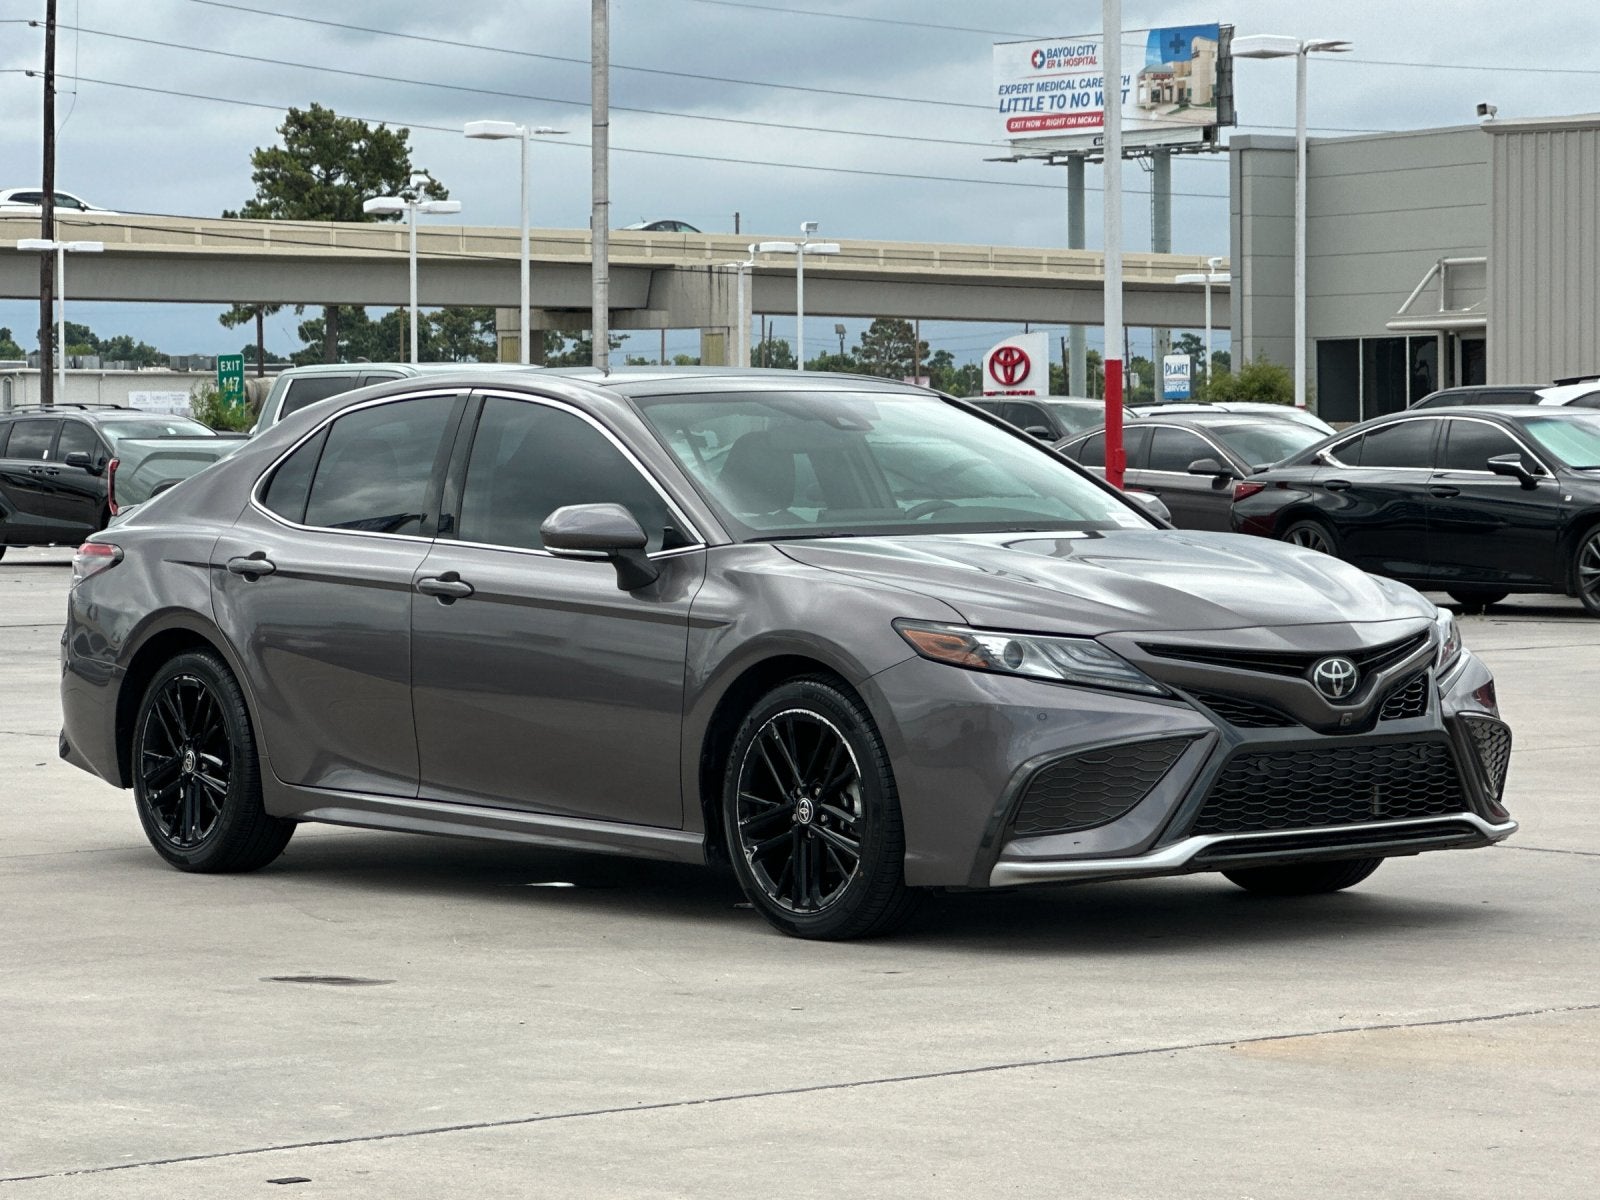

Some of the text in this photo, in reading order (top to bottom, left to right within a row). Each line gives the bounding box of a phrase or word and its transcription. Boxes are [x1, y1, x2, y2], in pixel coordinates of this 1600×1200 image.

[1047, 45, 1097, 59] BAYOU CITY
[1047, 56, 1097, 69] ER & HOSPITAL
[999, 77, 1104, 95] EXPERT MEDICAL CARE
[999, 96, 1045, 113] LITTLE
[1049, 94, 1067, 110] TO
[1070, 92, 1090, 108] NO
[1010, 120, 1025, 129] EXIT
[1026, 119, 1041, 128] NOW
[1045, 118, 1065, 127] RIGHT
[1066, 117, 1076, 125] ON
[220, 360, 240, 371] EXIT
[1165, 362, 1188, 376] PLANET
[222, 376, 240, 392] 147
[1164, 384, 1189, 392] SERVICE
